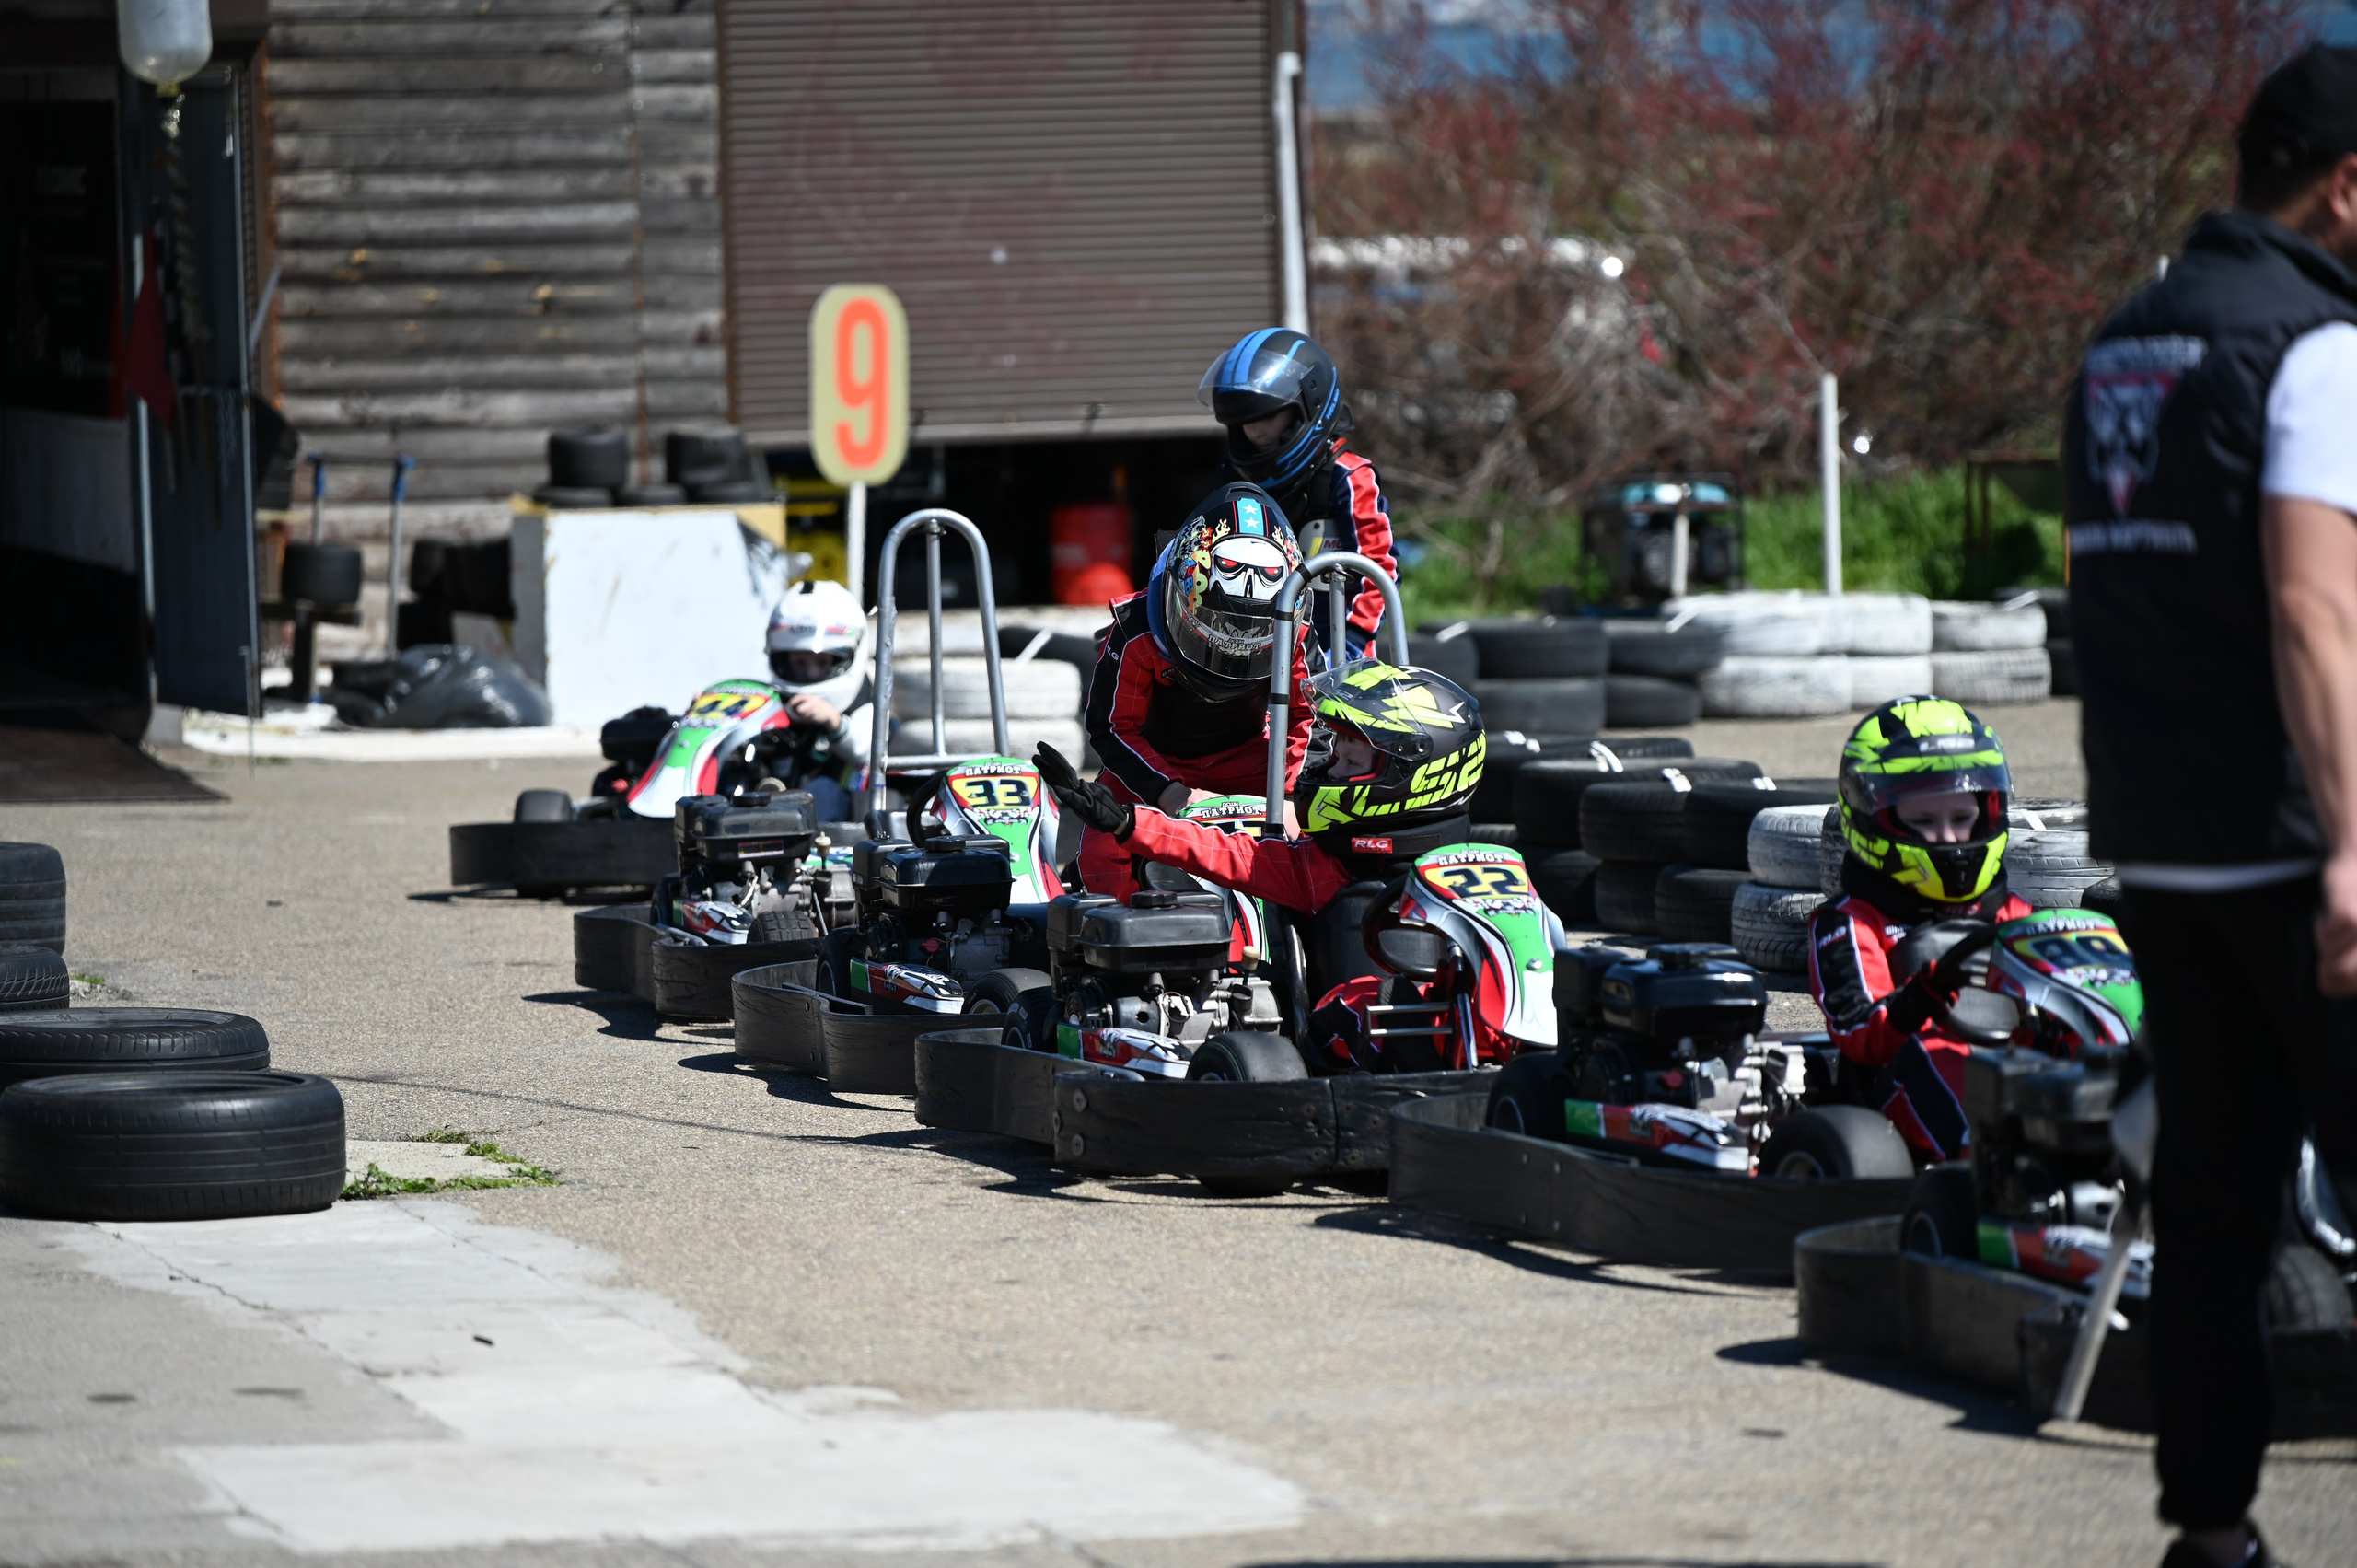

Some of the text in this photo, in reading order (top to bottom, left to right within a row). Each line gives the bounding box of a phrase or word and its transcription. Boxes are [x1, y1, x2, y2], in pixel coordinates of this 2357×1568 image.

[835, 296, 890, 471] 9
[1208, 634, 1261, 650] ПАТРИОТ
[965, 779, 1032, 807] 33
[1354, 839, 1388, 848] RLG
[1441, 866, 1531, 899] 22
